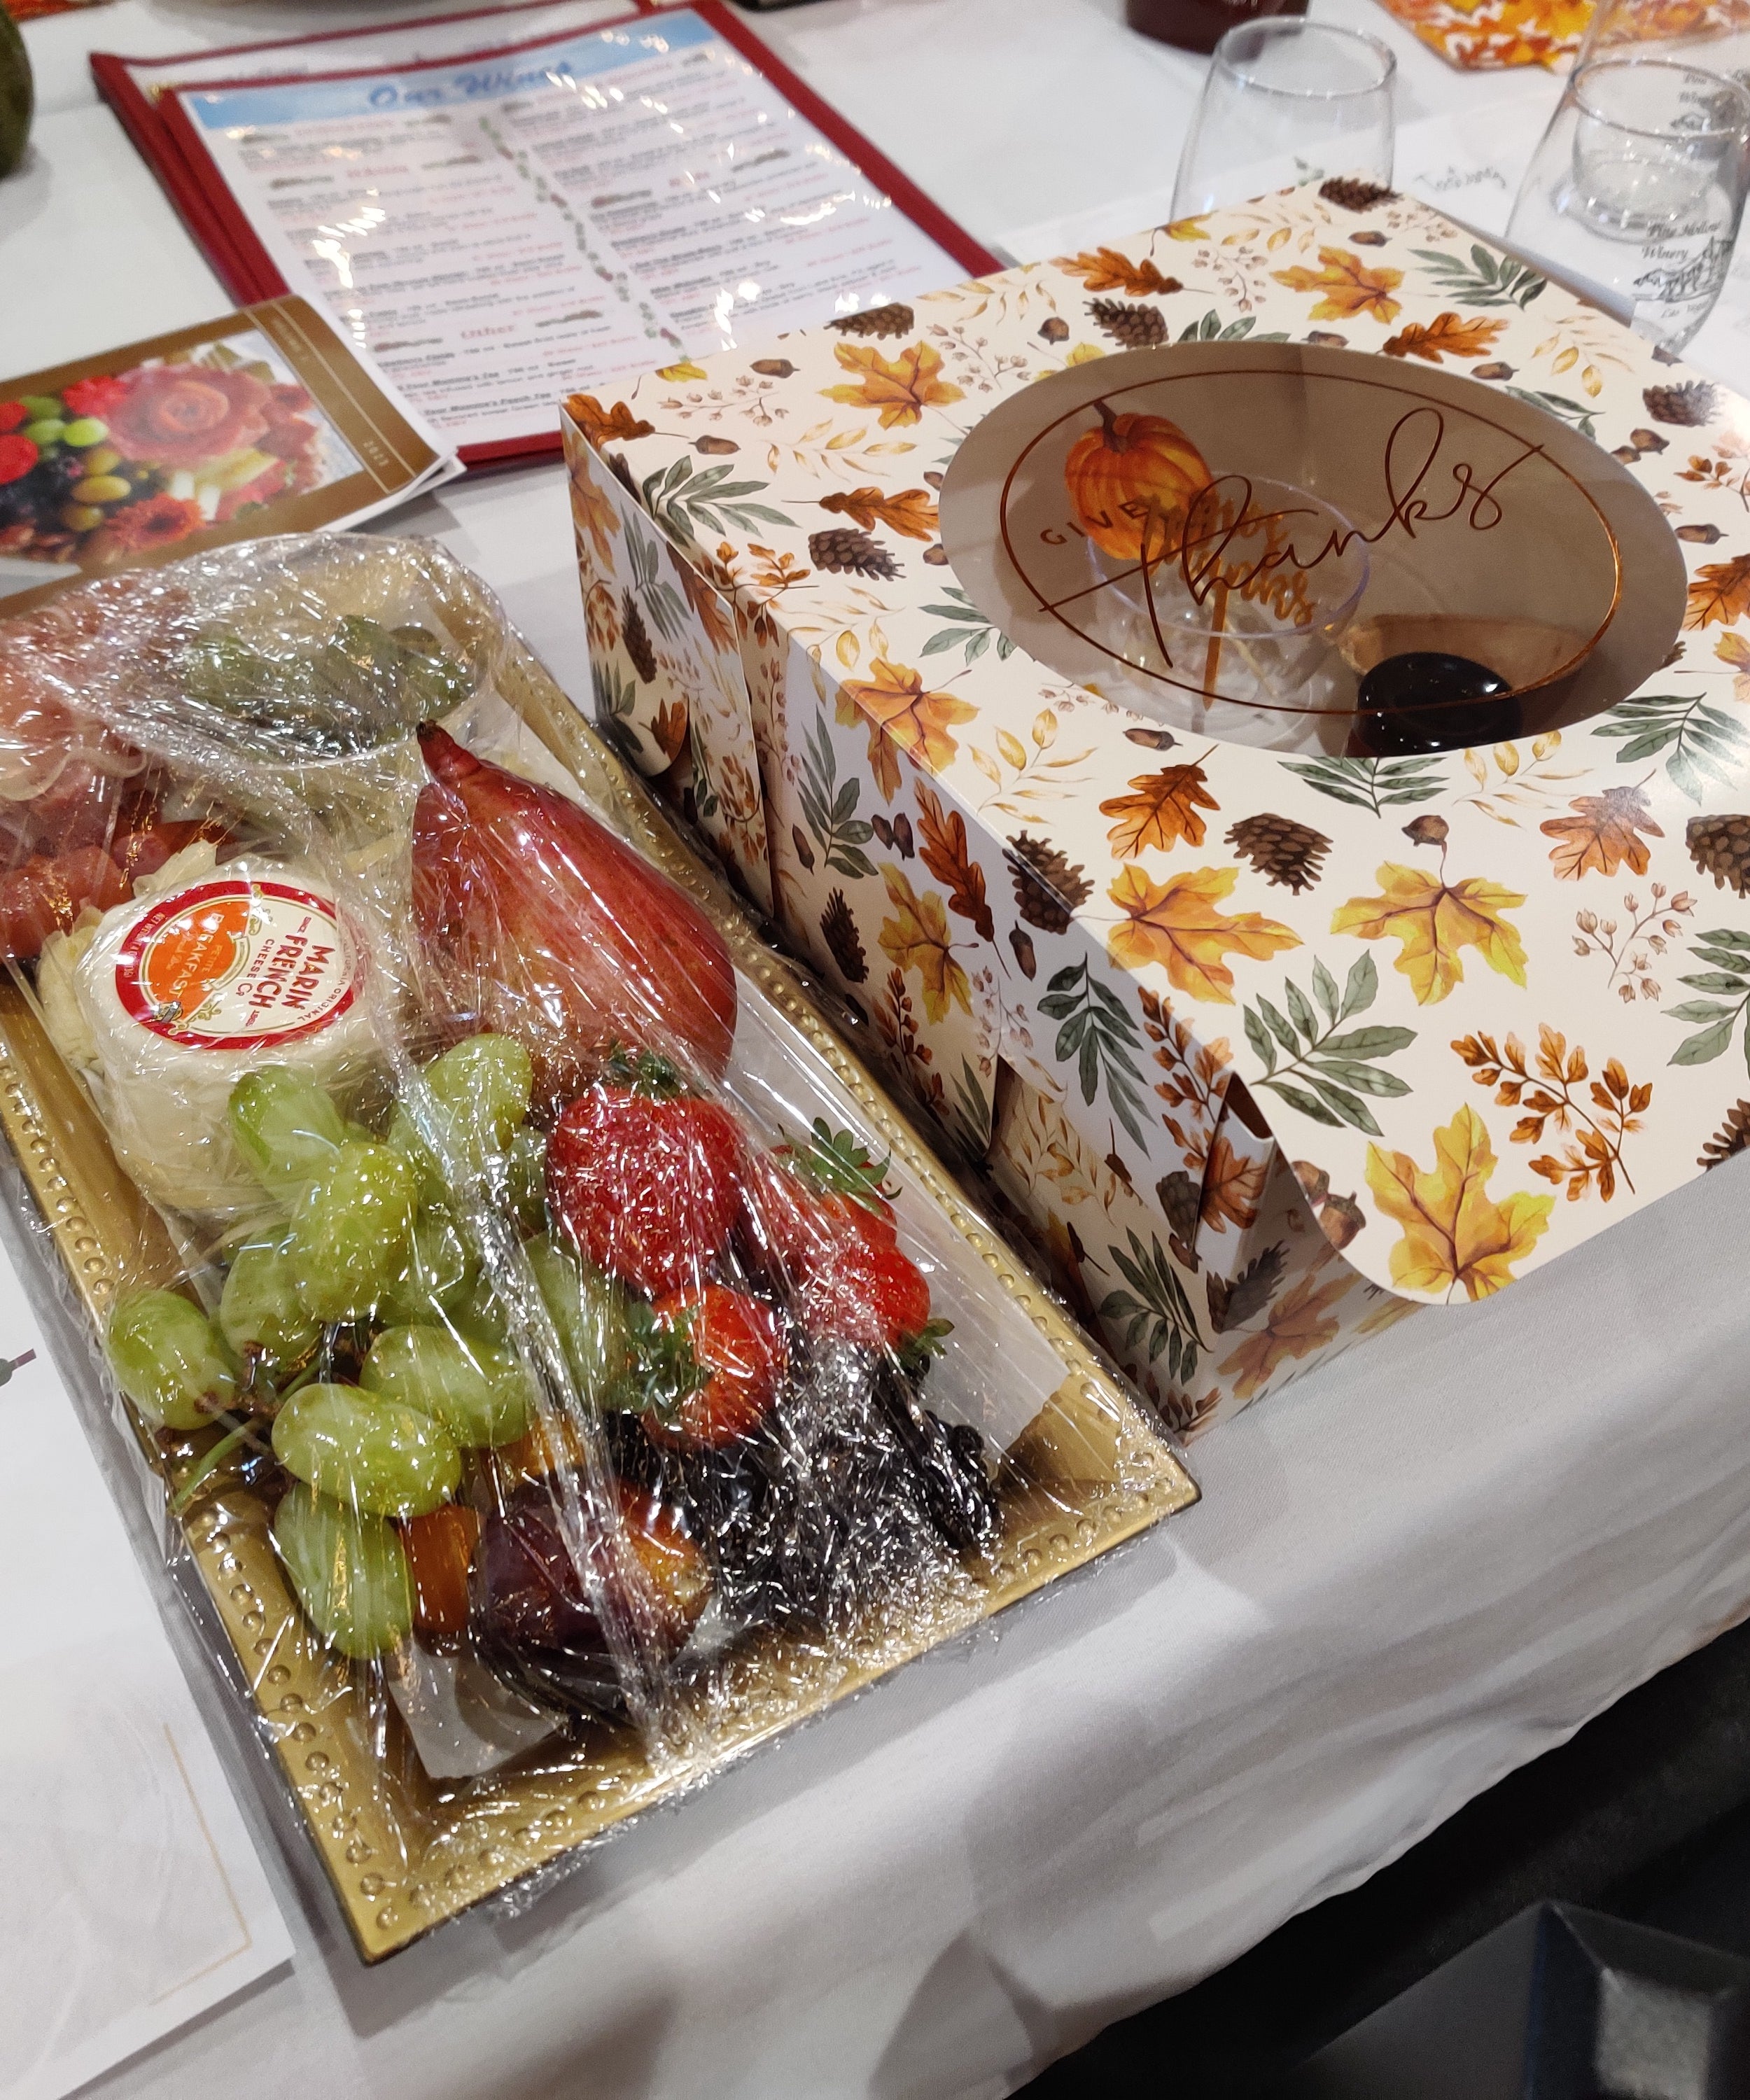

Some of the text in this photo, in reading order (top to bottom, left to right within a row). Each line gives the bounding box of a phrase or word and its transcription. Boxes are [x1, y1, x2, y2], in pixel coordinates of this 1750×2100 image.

[1040, 498, 1152, 547] GIVE
[202, 944, 223, 973] PETITE
[246, 938, 275, 979] CHEESE
[248, 934, 308, 1009] FRENCH
[281, 944, 336, 1011] MARIN
[297, 988, 342, 1022] ORIGINAL
